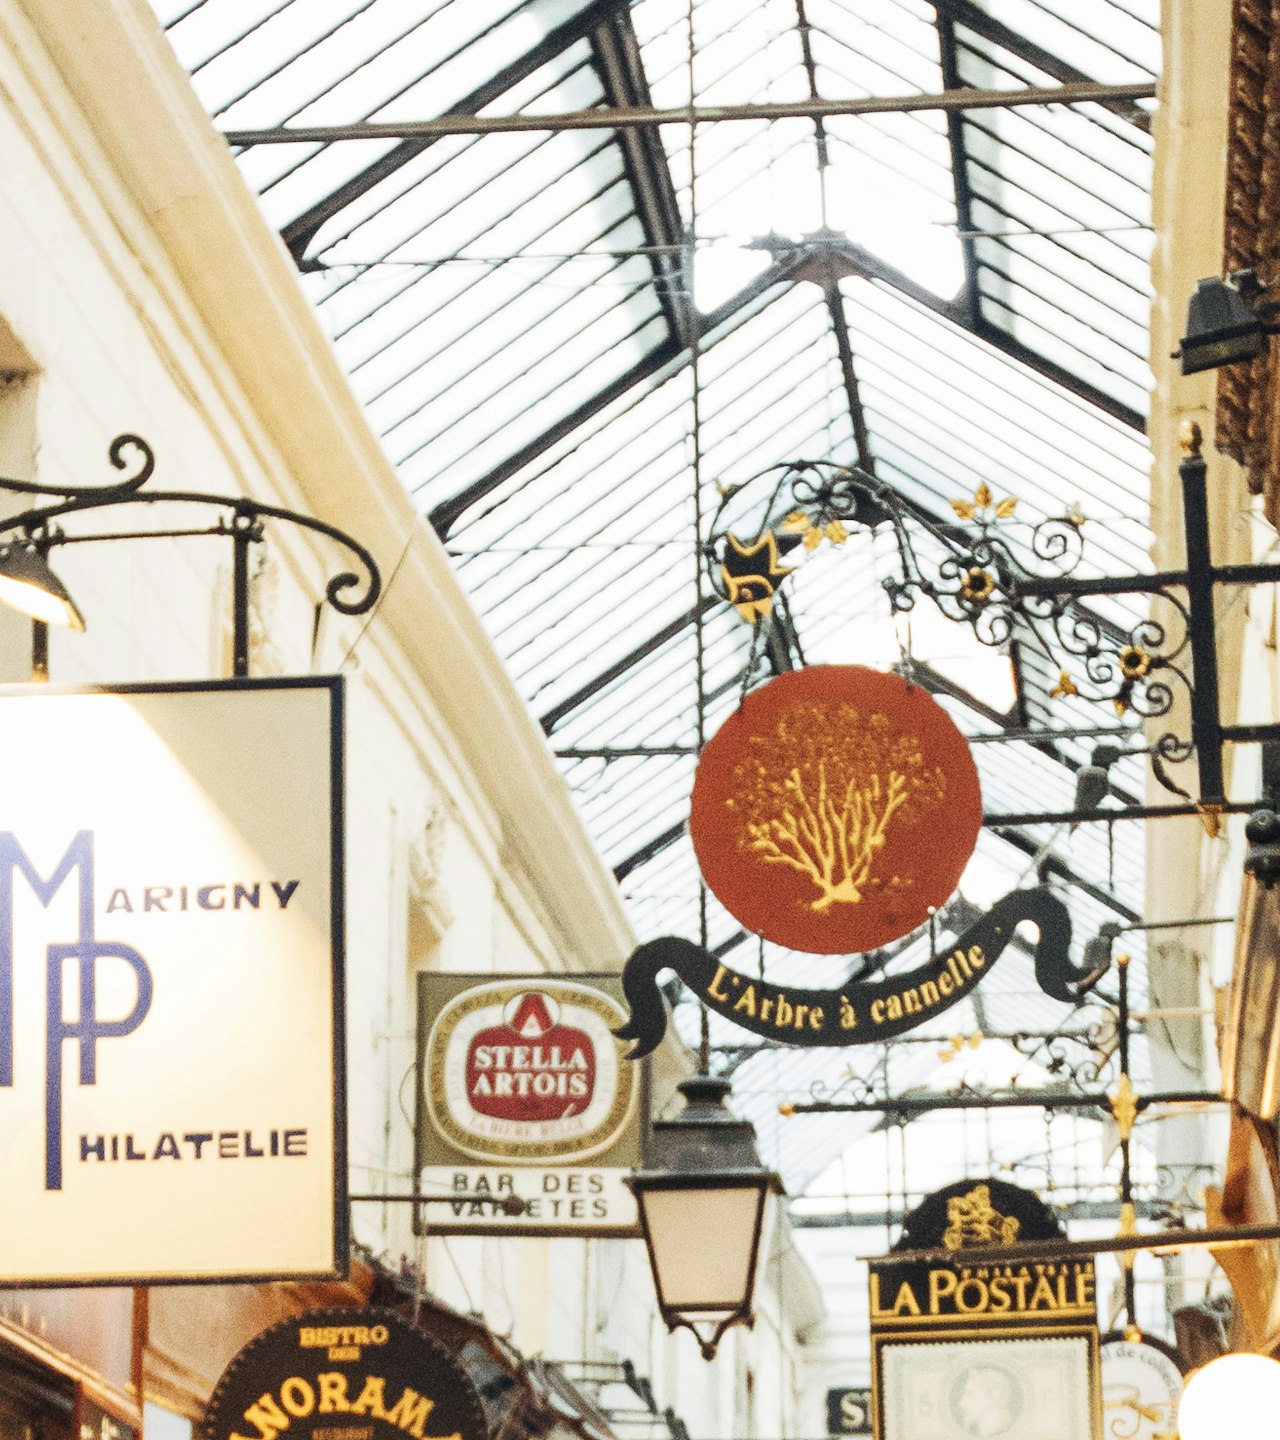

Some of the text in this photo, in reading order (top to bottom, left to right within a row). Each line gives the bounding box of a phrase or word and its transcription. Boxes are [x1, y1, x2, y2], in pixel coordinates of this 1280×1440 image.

[706, 945, 986, 1031] L'Arbre à cannelle
[473, 1045, 589, 1071] STELLA
[472, 1072, 589, 1098] ARTOIS
[451, 1173, 604, 1194] BAR DES
[870, 1268, 1095, 1317] LA POSTALE
[299, 1324, 390, 1348] BISTRO
